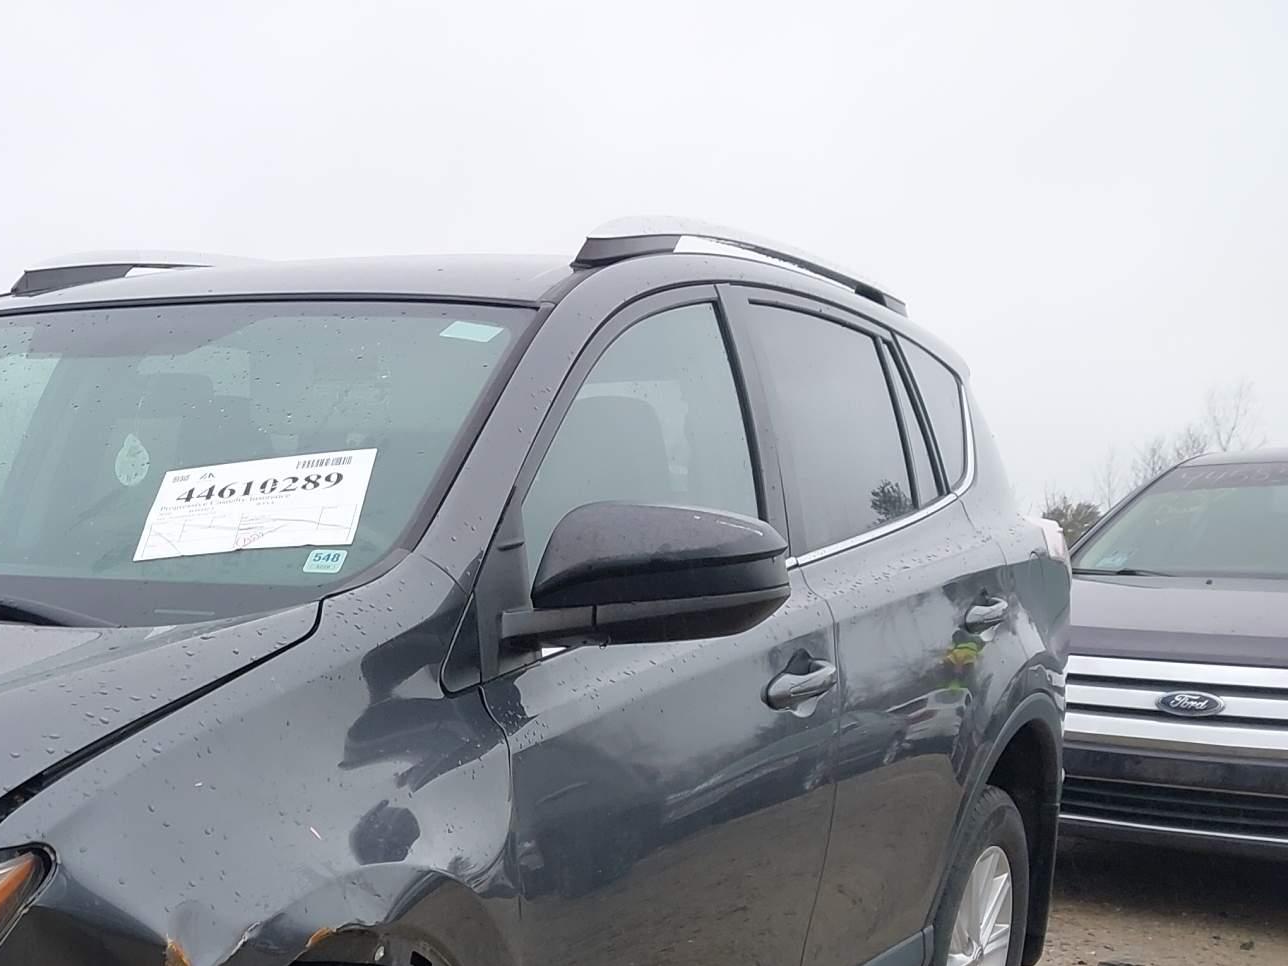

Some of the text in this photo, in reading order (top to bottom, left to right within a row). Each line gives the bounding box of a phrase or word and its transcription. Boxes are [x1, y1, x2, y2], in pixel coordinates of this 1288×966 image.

[176, 471, 344, 503] 44610289
[312, 552, 341, 563] 548
[1170, 694, 1209, 710] Ford
